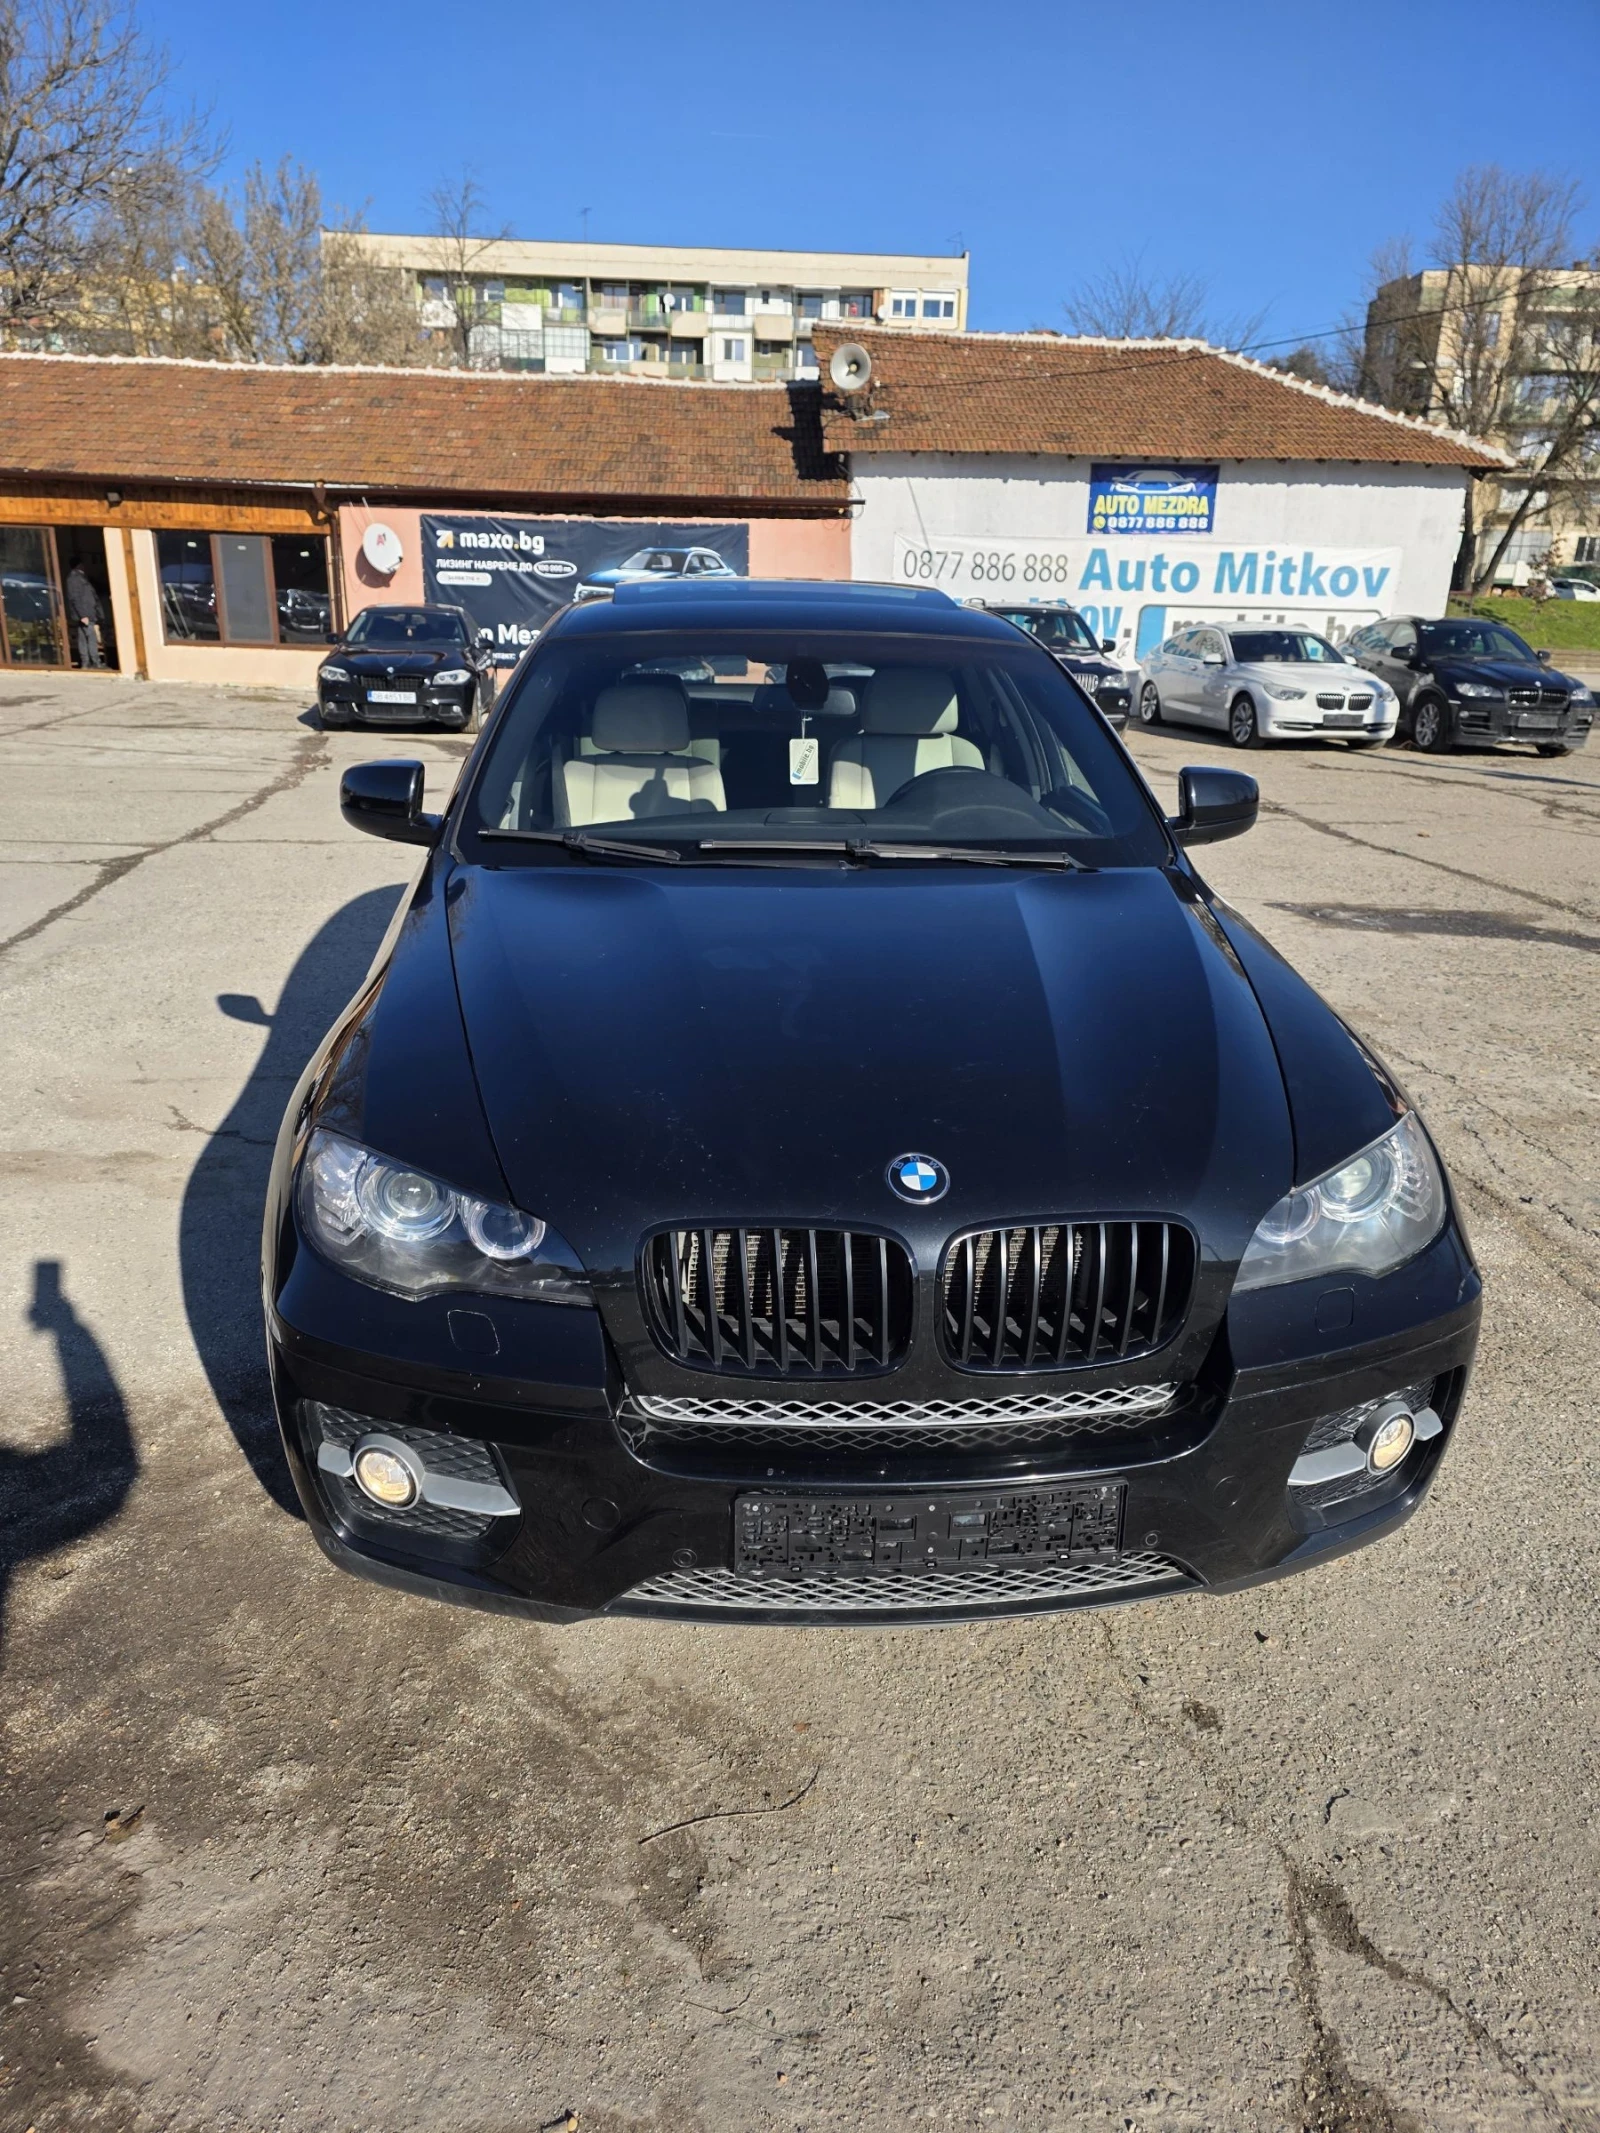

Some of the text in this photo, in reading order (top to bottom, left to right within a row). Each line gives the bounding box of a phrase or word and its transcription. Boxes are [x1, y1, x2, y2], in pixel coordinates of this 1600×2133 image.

[1093, 494, 1209, 516] AUTO MEZDRA
[1107, 516, 1143, 529] 0877
[1145, 516, 1176, 529] 886
[459, 530, 545, 555] maxo.bg
[435, 558, 473, 570] ЛИЗИНГ
[474, 560, 518, 572] НАВРЕМЕ
[518, 562, 533, 573] ДО
[903, 549, 1069, 583] 0877 886 888
[1078, 547, 1391, 598] Auto Mitkov
[497, 623, 541, 646] Мез
[893, 1155, 940, 1170] BMW
